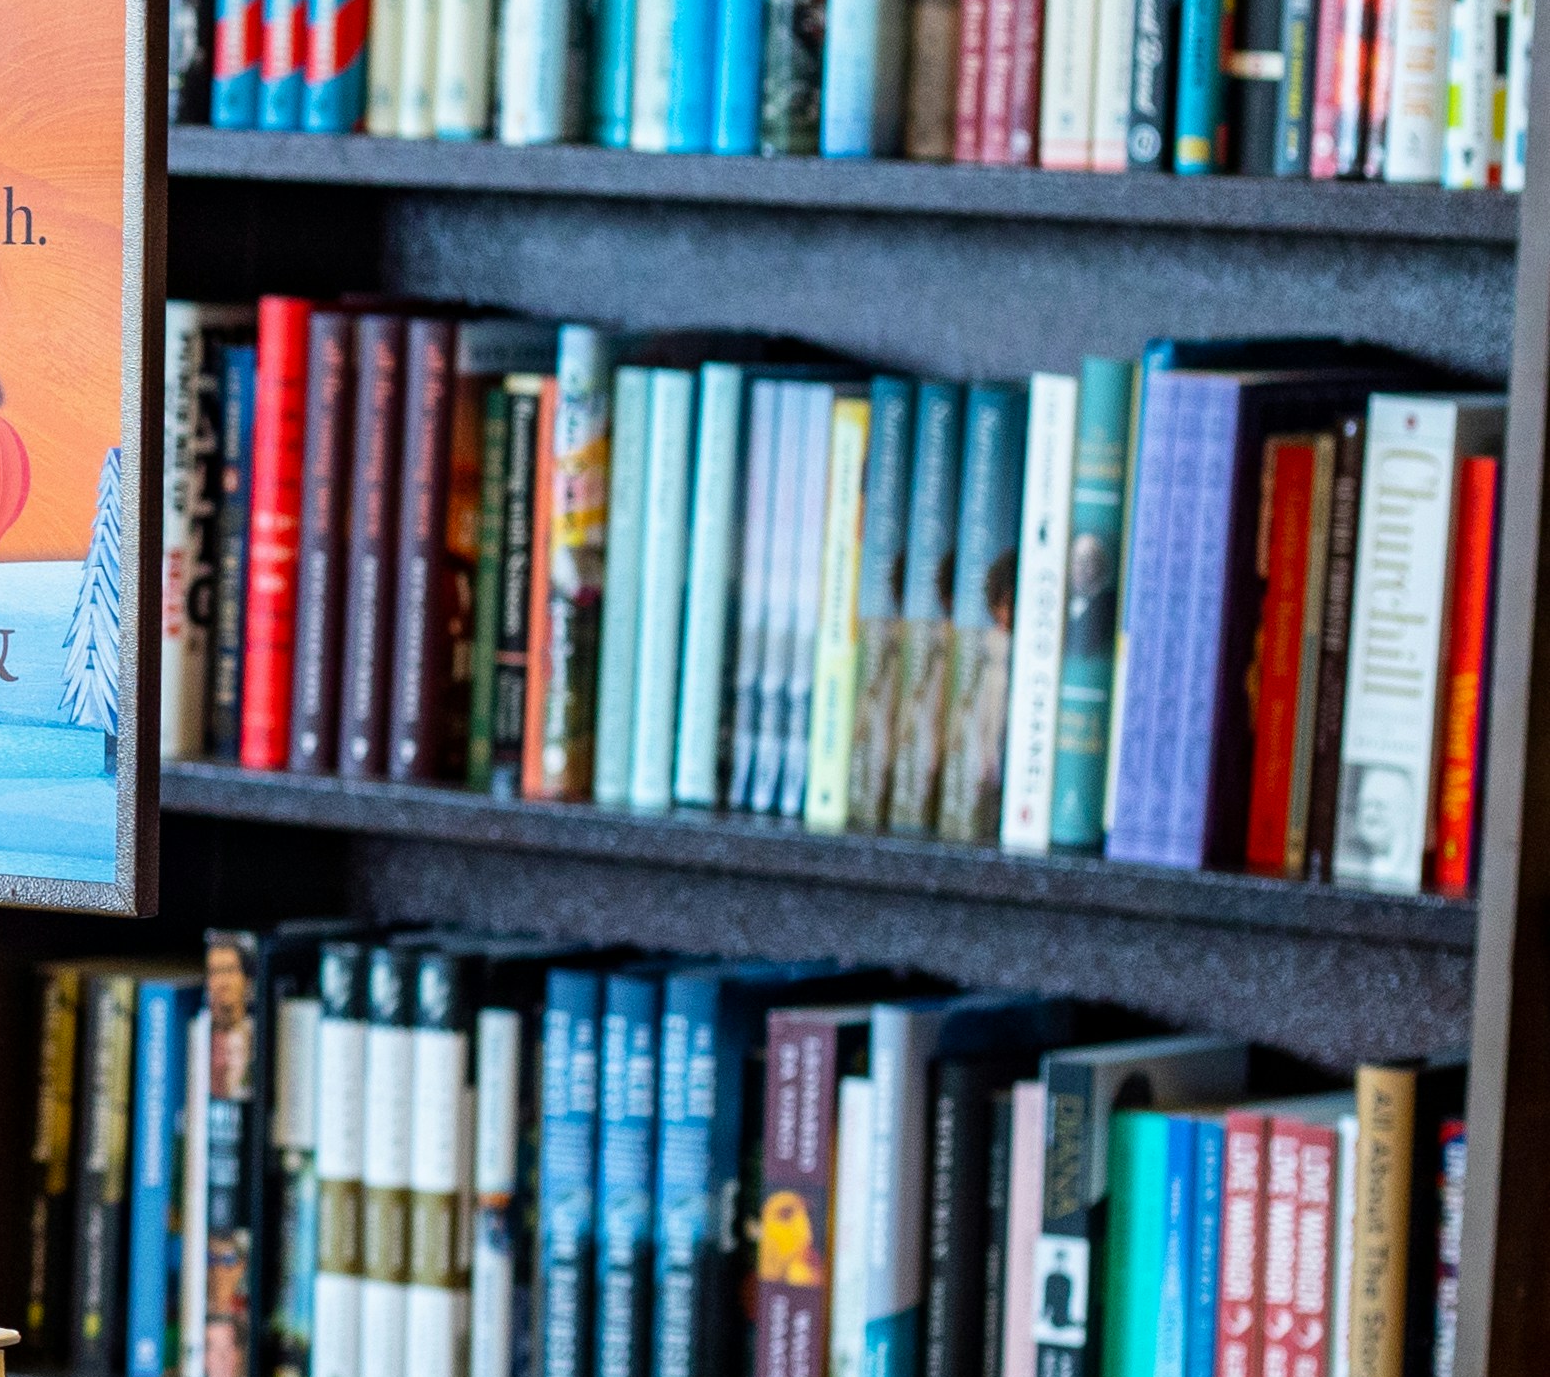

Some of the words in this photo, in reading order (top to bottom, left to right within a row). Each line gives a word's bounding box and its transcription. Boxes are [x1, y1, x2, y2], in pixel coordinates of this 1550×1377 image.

[1362, 447, 1448, 701] Churchill
[1371, 1089, 1394, 1131] All
[1366, 1141, 1390, 1232] About
[1364, 1244, 1391, 1302] The
